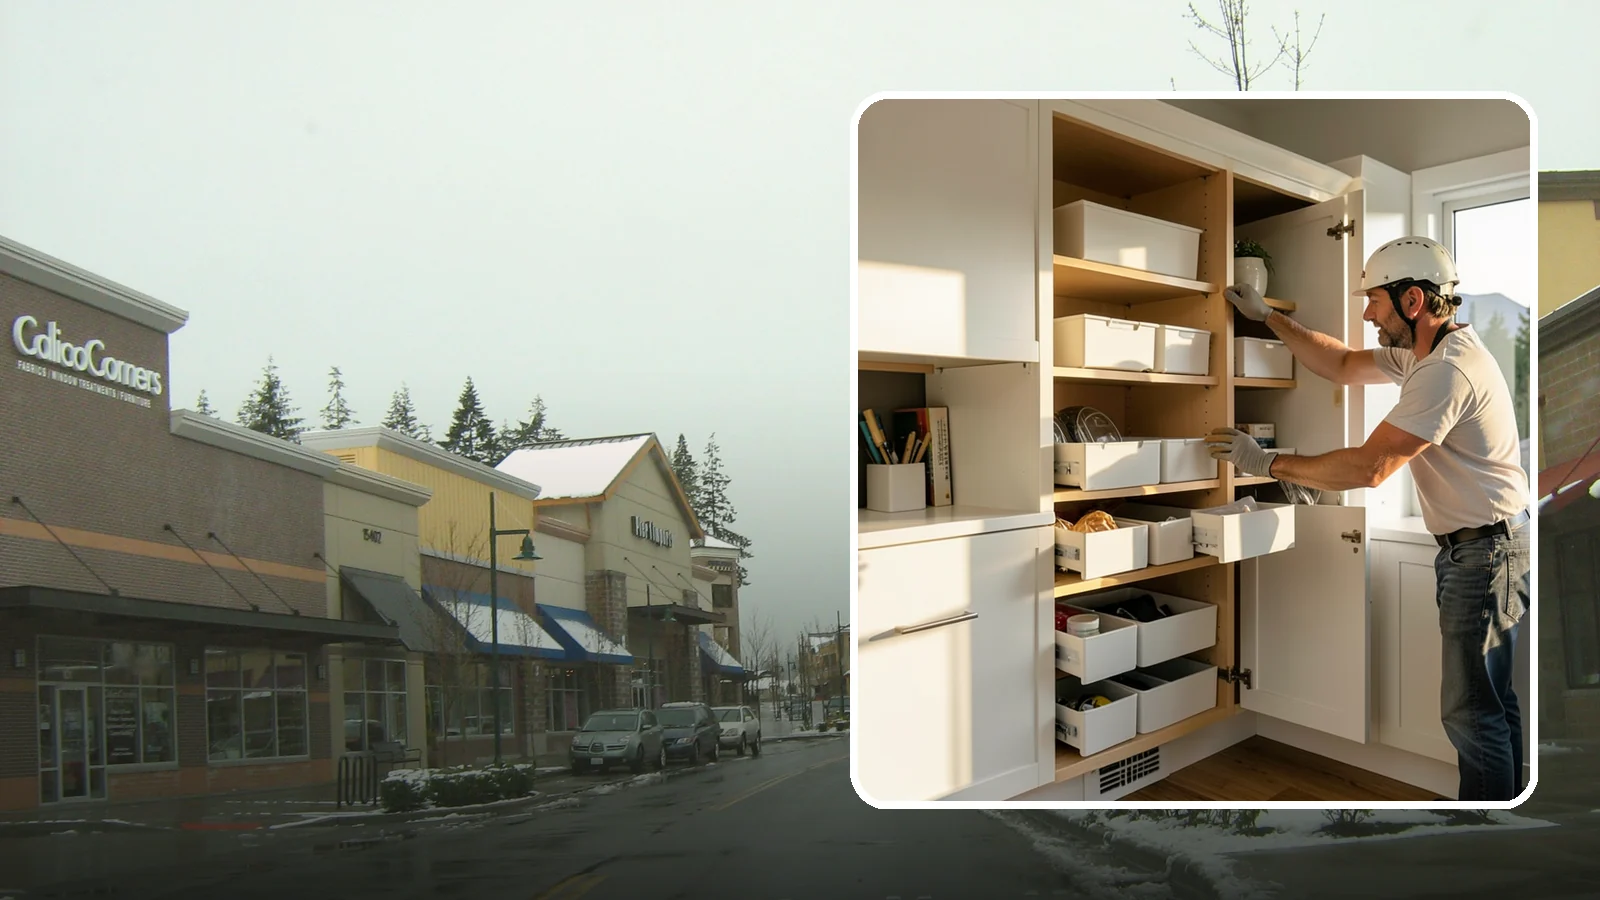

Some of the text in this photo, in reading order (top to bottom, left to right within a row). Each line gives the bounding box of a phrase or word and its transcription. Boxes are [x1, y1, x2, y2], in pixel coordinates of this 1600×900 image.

[17, 360, 151, 408] FABRICS WINDOW TREATMENTS FURNITURE
